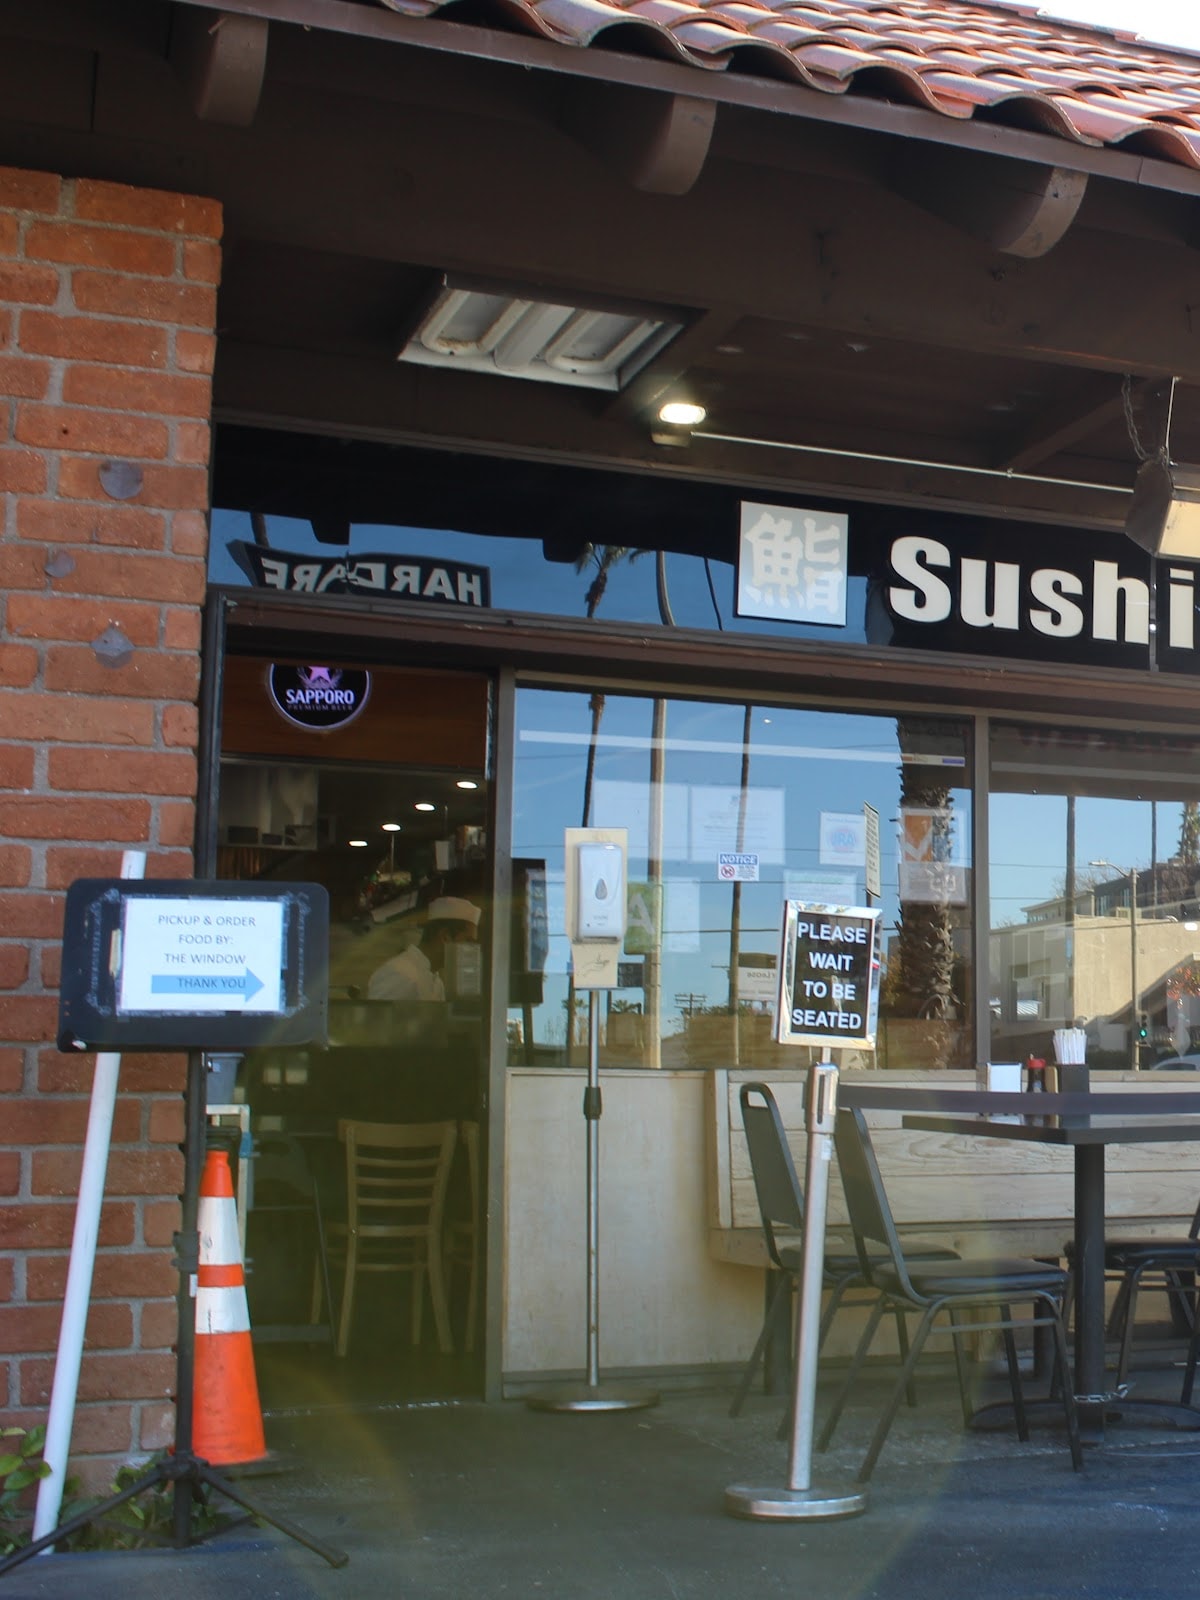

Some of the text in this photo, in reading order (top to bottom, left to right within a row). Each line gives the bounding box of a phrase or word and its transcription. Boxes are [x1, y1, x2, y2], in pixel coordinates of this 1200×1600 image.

[286, 688, 355, 705] SAPPORO
[721, 854, 758, 864] NOTICE
[158, 914, 256, 927] PICKUP & ORDER
[178, 934, 213, 945] FOOD
[797, 921, 867, 945] PLEASE
[164, 953, 246, 964] THE WINDOW
[809, 951, 854, 972] WAIT
[177, 977, 246, 989] THANK YOU
[803, 980, 856, 1001] TO BE
[792, 1008, 862, 1029] SEATED
